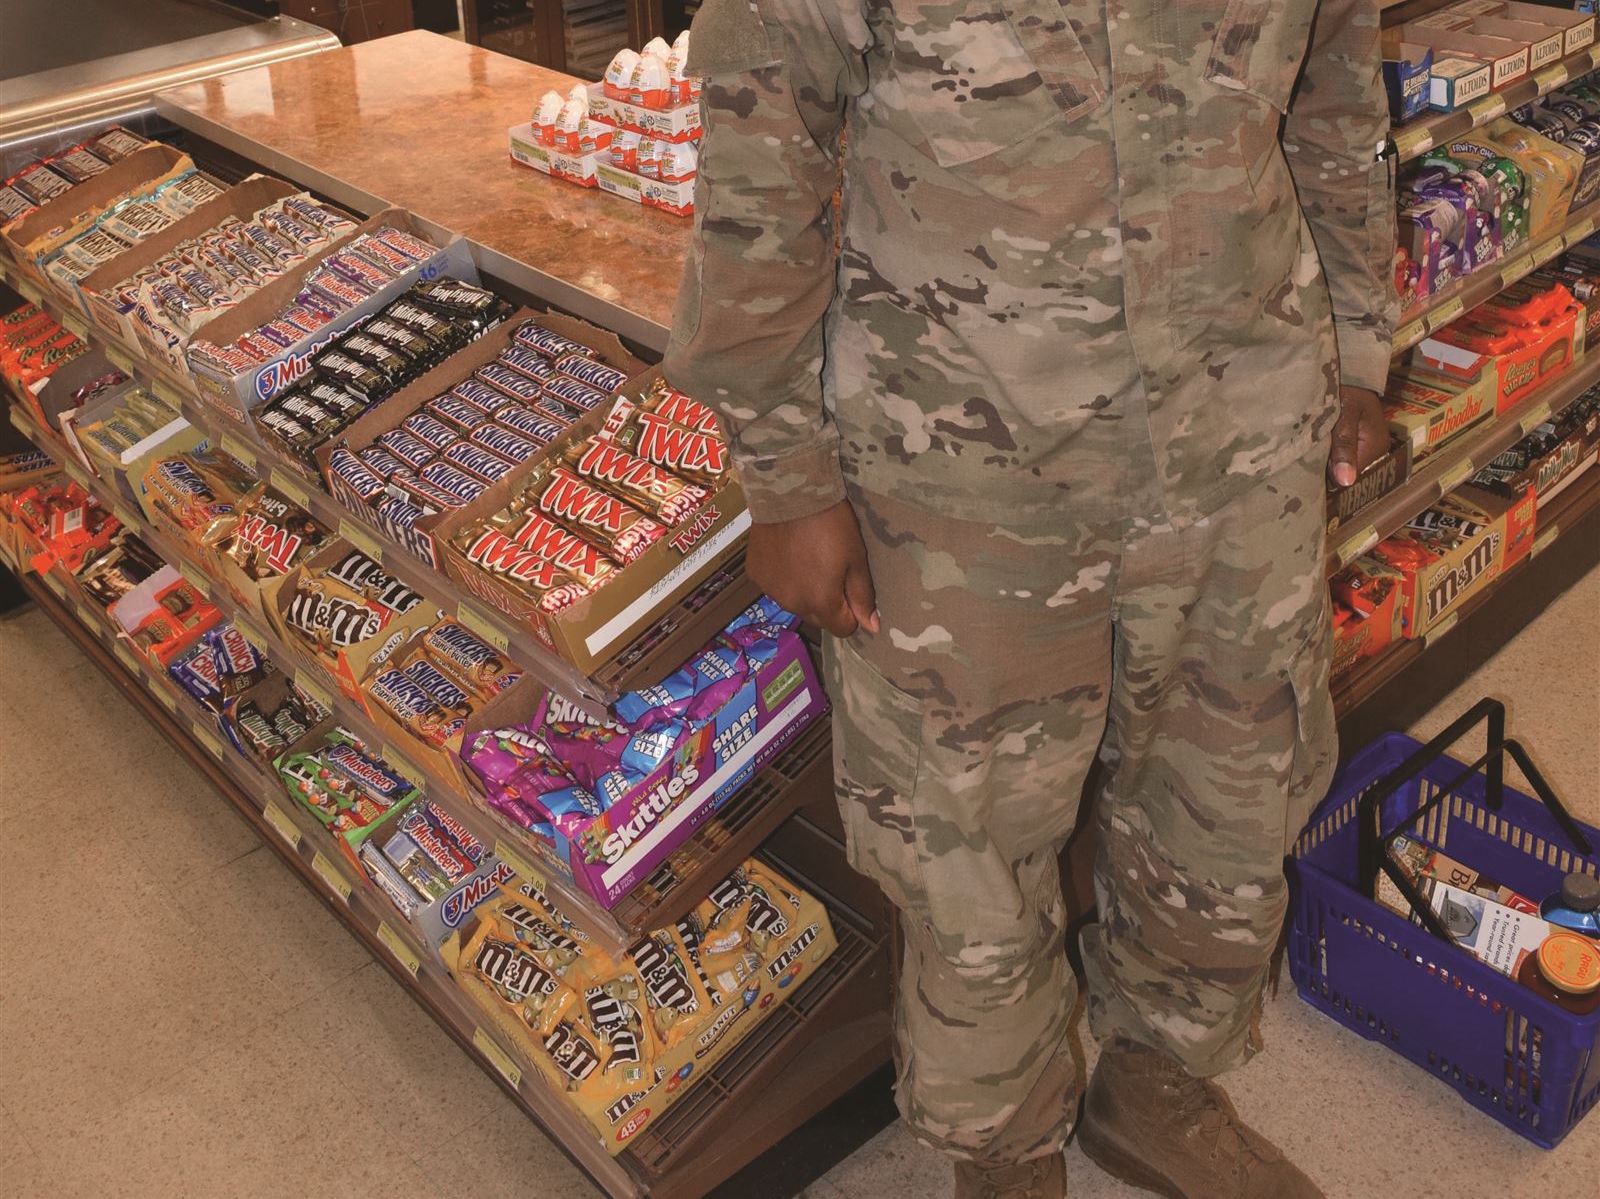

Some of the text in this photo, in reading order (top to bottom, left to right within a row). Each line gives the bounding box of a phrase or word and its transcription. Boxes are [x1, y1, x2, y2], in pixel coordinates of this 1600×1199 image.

[1534, 38, 1560, 61] ALTOIDS
[1568, 26, 1592, 46] ALTOIDS
[1457, 74, 1488, 94] ALTOIDS
[1497, 56, 1525, 79] ALTOIDS
[1452, 143, 1479, 154] FRUITY
[263, 369, 274, 393] 3
[482, 363, 542, 399] SNICKERS
[560, 356, 627, 392] SNICKERS
[637, 412, 728, 473] TWIX
[331, 450, 384, 497] SNICKERS
[577, 434, 675, 495] TWIX
[259, 494, 288, 517] bites
[541, 467, 634, 532] TWIX
[1339, 456, 1397, 519] HERSHEY'S
[233, 513, 302, 575] Twix
[514, 506, 609, 578] TWIX
[669, 504, 722, 555] Twix
[467, 524, 566, 589] TWIX
[1427, 531, 1501, 625] m&m's
[286, 588, 382, 646] m&m's
[222, 628, 256, 674] CRUNCH
[372, 630, 405, 664] PEANUT
[434, 623, 496, 664] SNICKERS
[404, 660, 469, 709] SNICKERS
[697, 660, 722, 681] SIZE
[703, 650, 736, 679] SHARE
[633, 740, 663, 759] SIZE
[711, 704, 760, 754] SHARE
[721, 726, 754, 764] SIZE
[342, 750, 398, 794] Musketeers
[601, 764, 700, 865] Skittles
[412, 824, 464, 881] Musketeers
[447, 897, 459, 919] 3
[608, 885, 621, 901] 24
[768, 921, 821, 981] m&m's
[1489, 917, 1500, 953] Year-round
[1501, 921, 1509, 944] Trusted
[475, 936, 560, 996] m&m's
[629, 932, 702, 1016] m&m's
[700, 1007, 737, 1045] PEANUT
[620, 1119, 638, 1140] 48
